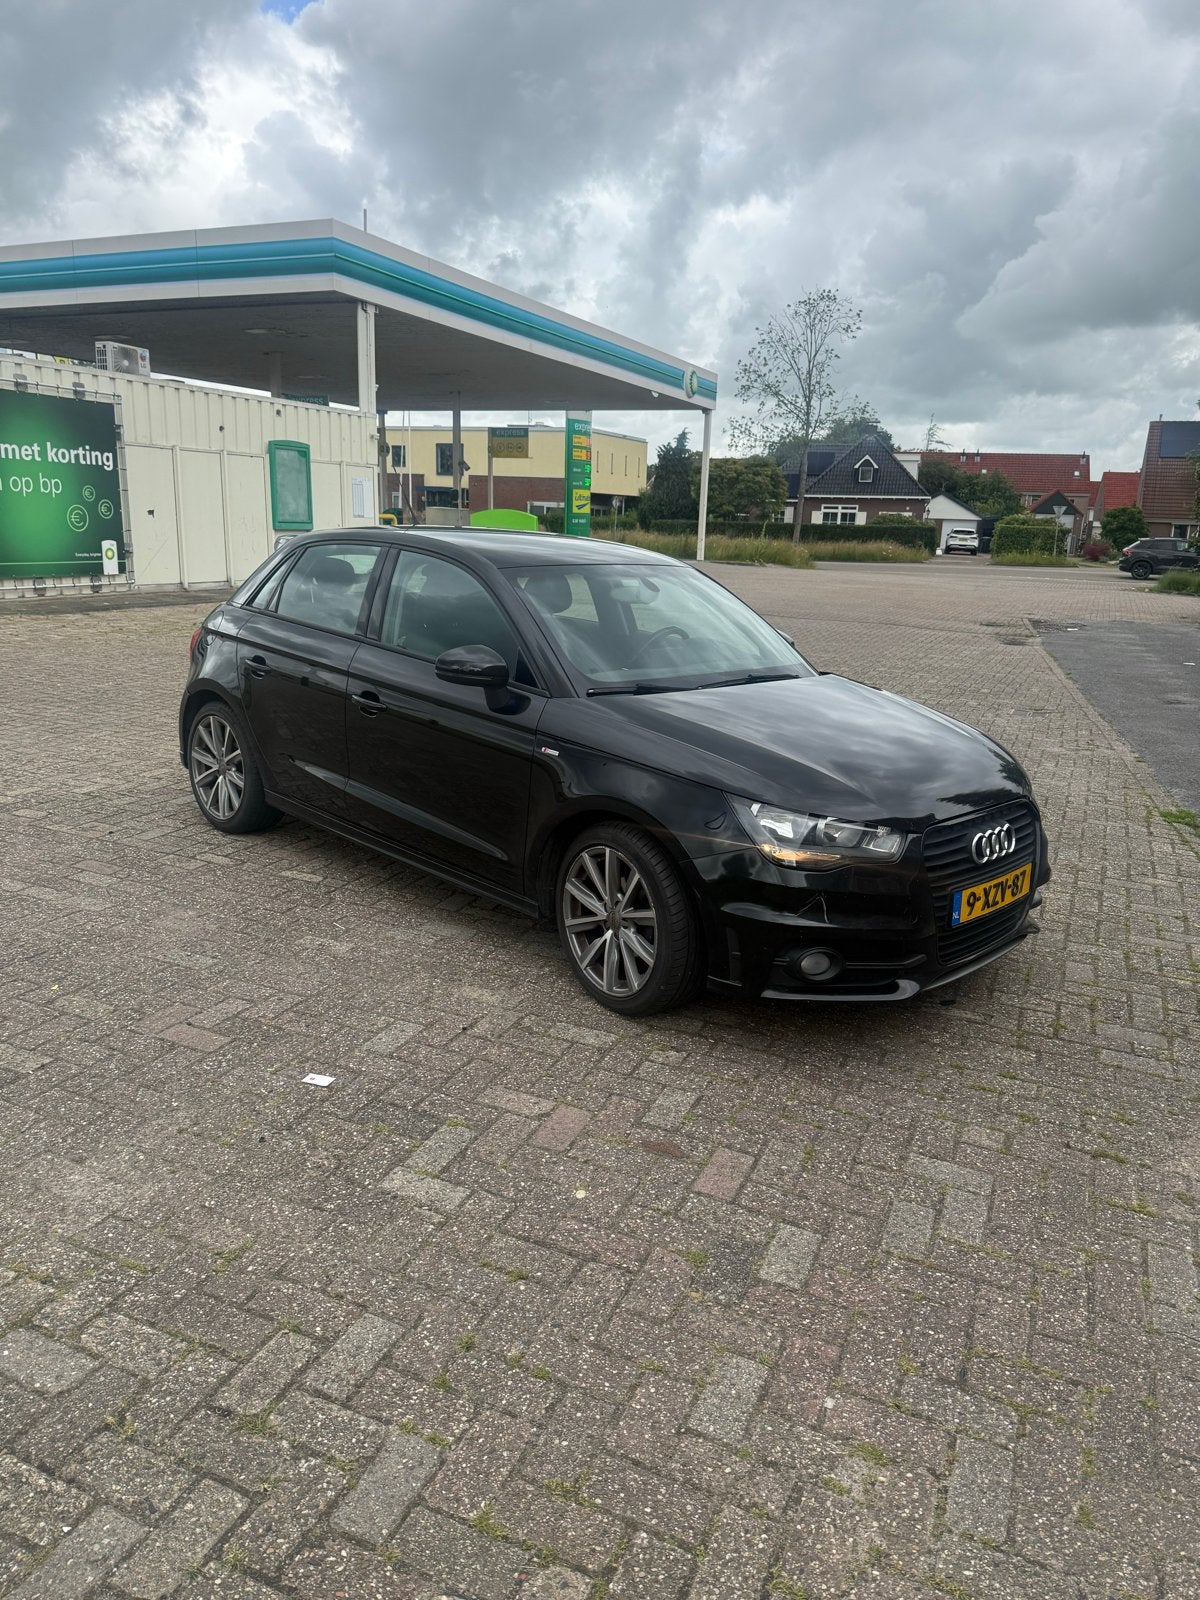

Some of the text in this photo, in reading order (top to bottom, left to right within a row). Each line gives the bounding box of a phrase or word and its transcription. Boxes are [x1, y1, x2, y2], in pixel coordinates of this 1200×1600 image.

[0, 442, 114, 471] met korting
[10, 476, 33, 497] op
[40, 472, 62, 498] bp
[966, 870, 1027, 917] 9-XZV-87
[952, 911, 960, 920] NL
